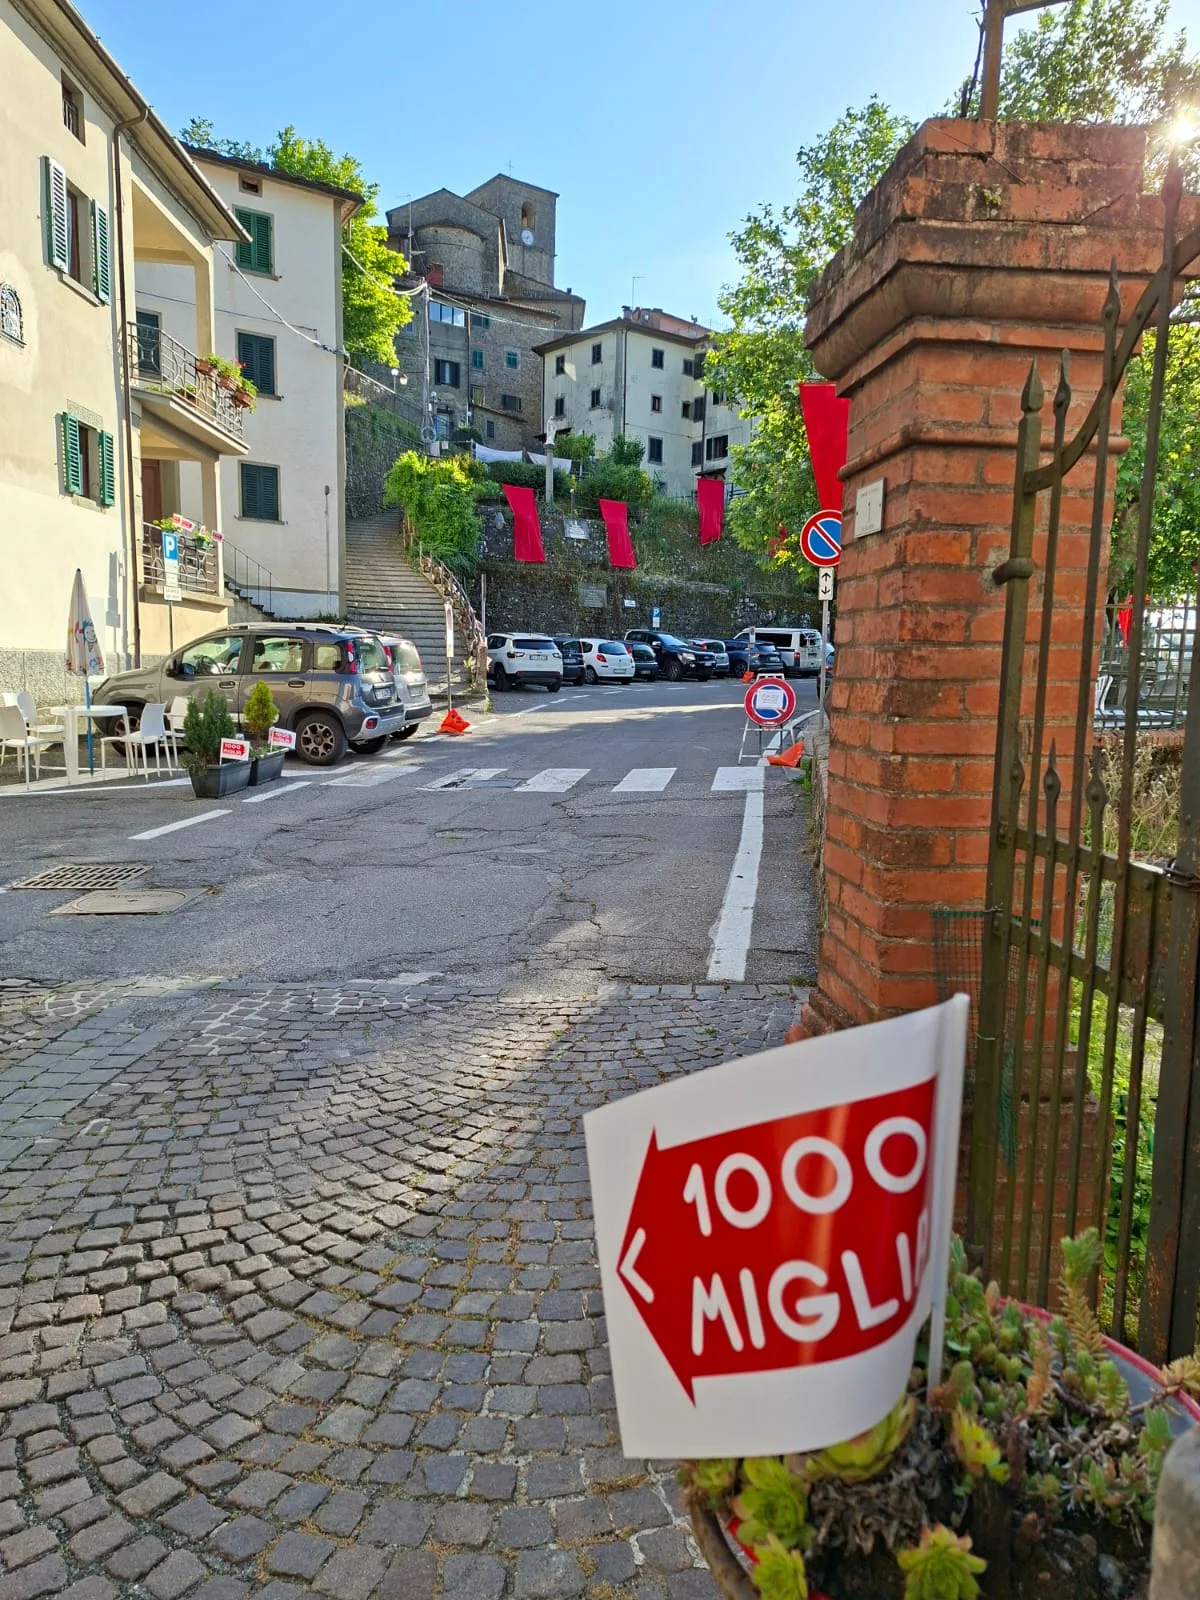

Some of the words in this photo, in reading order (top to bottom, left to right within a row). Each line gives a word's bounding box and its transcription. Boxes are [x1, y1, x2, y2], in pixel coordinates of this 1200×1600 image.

[166, 536, 175, 558] P
[653, 608, 660, 616] P
[682, 1116, 927, 1237] 1000
